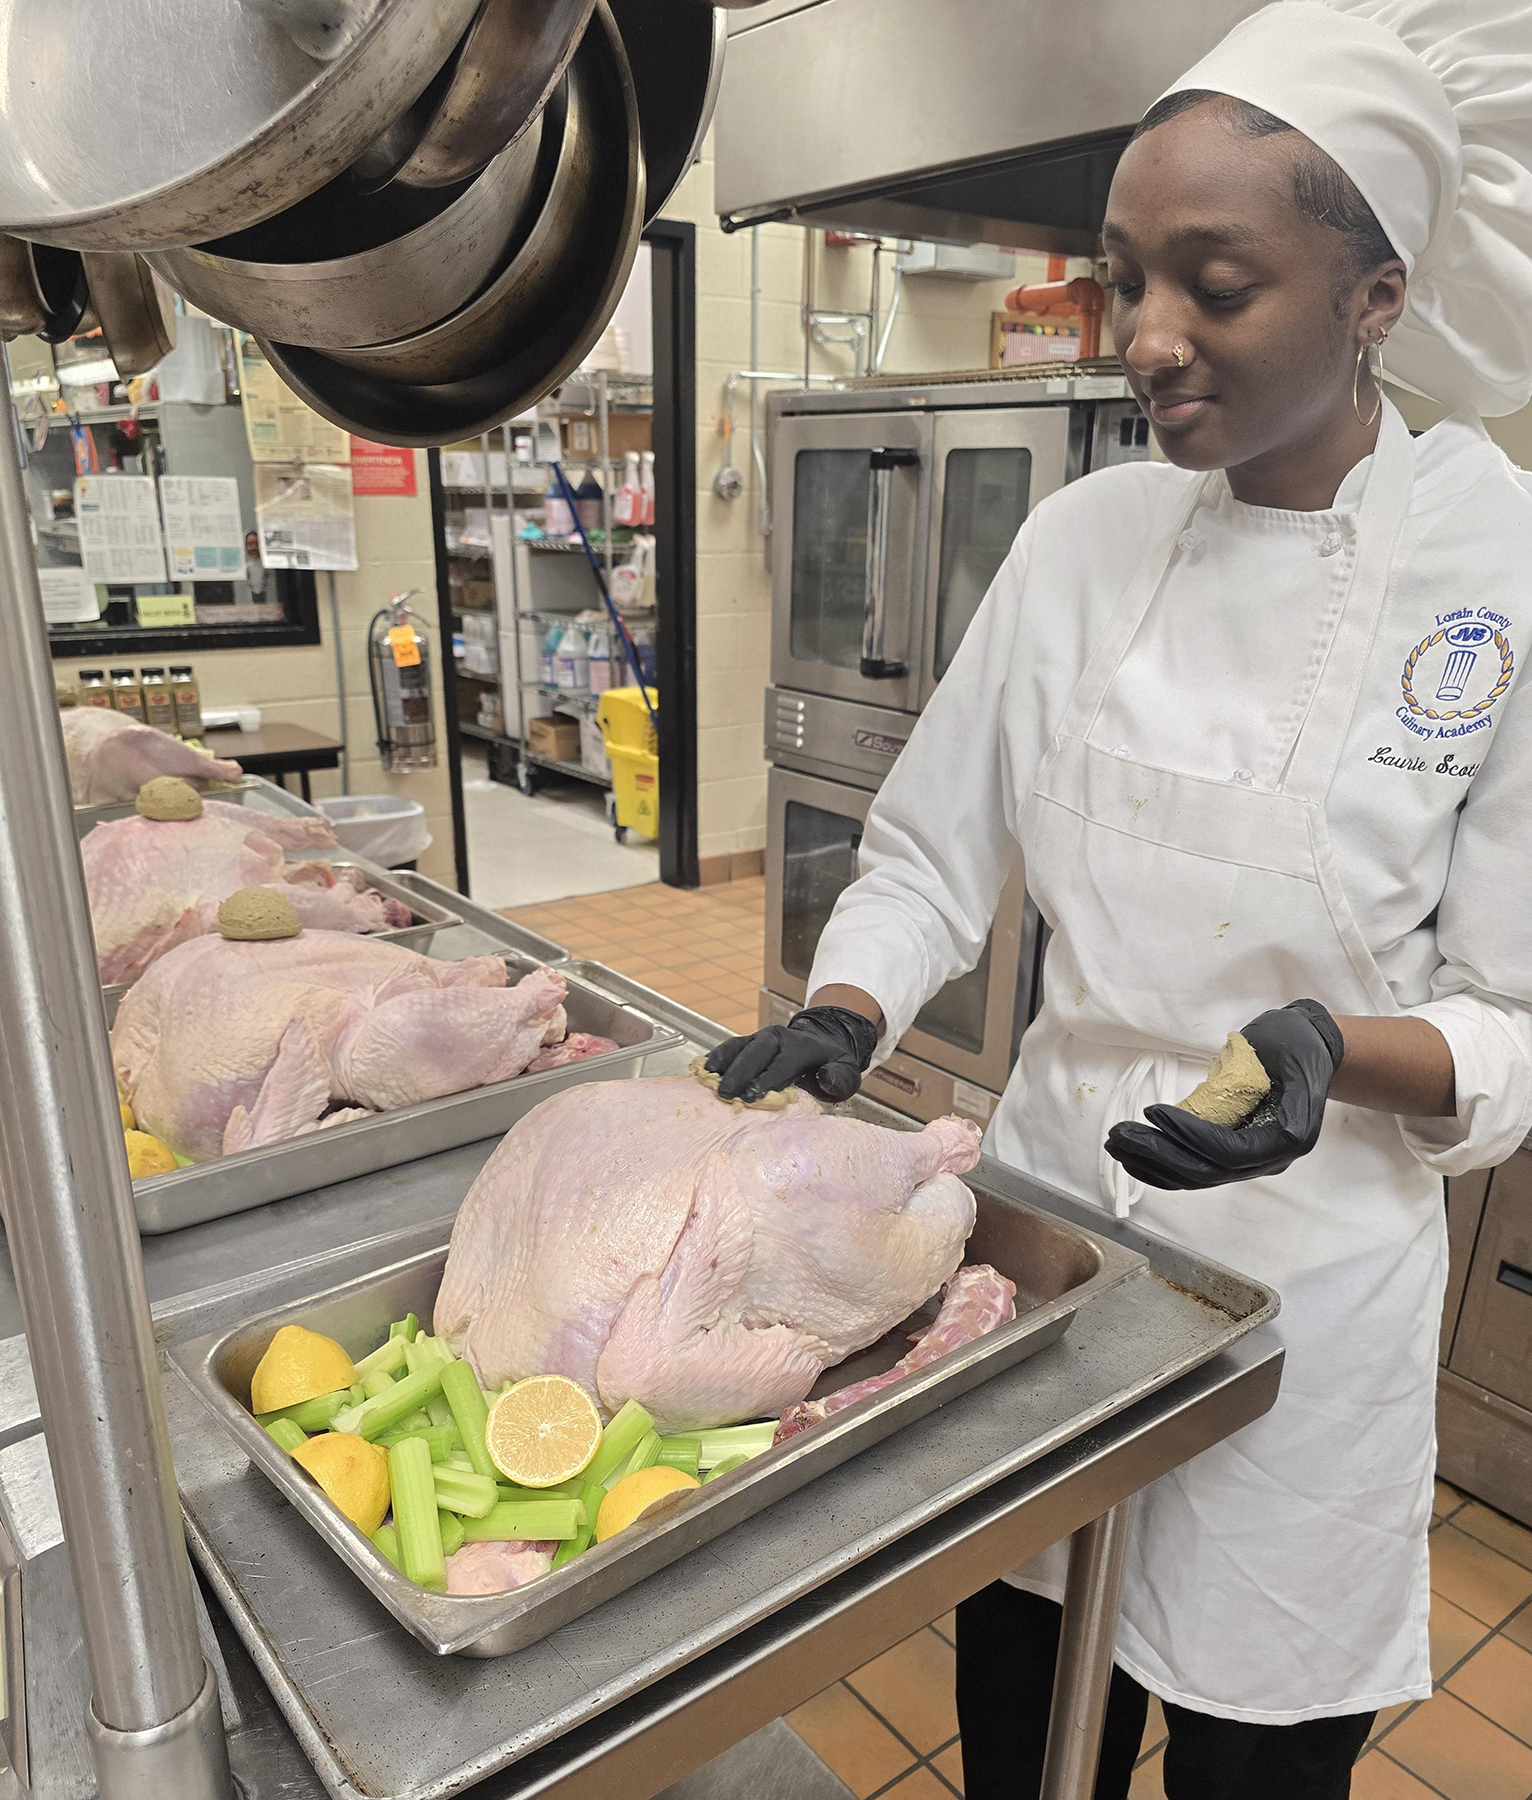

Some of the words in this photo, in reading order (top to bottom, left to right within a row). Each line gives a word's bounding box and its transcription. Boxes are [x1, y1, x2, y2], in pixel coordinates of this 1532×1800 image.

[1435, 607, 1473, 627] Lorain
[1476, 606, 1512, 631] County
[1450, 627, 1487, 642] JVS
[1396, 706, 1433, 741] Culinary
[1435, 714, 1493, 739] Academy
[1368, 747, 1428, 772] Laurie
